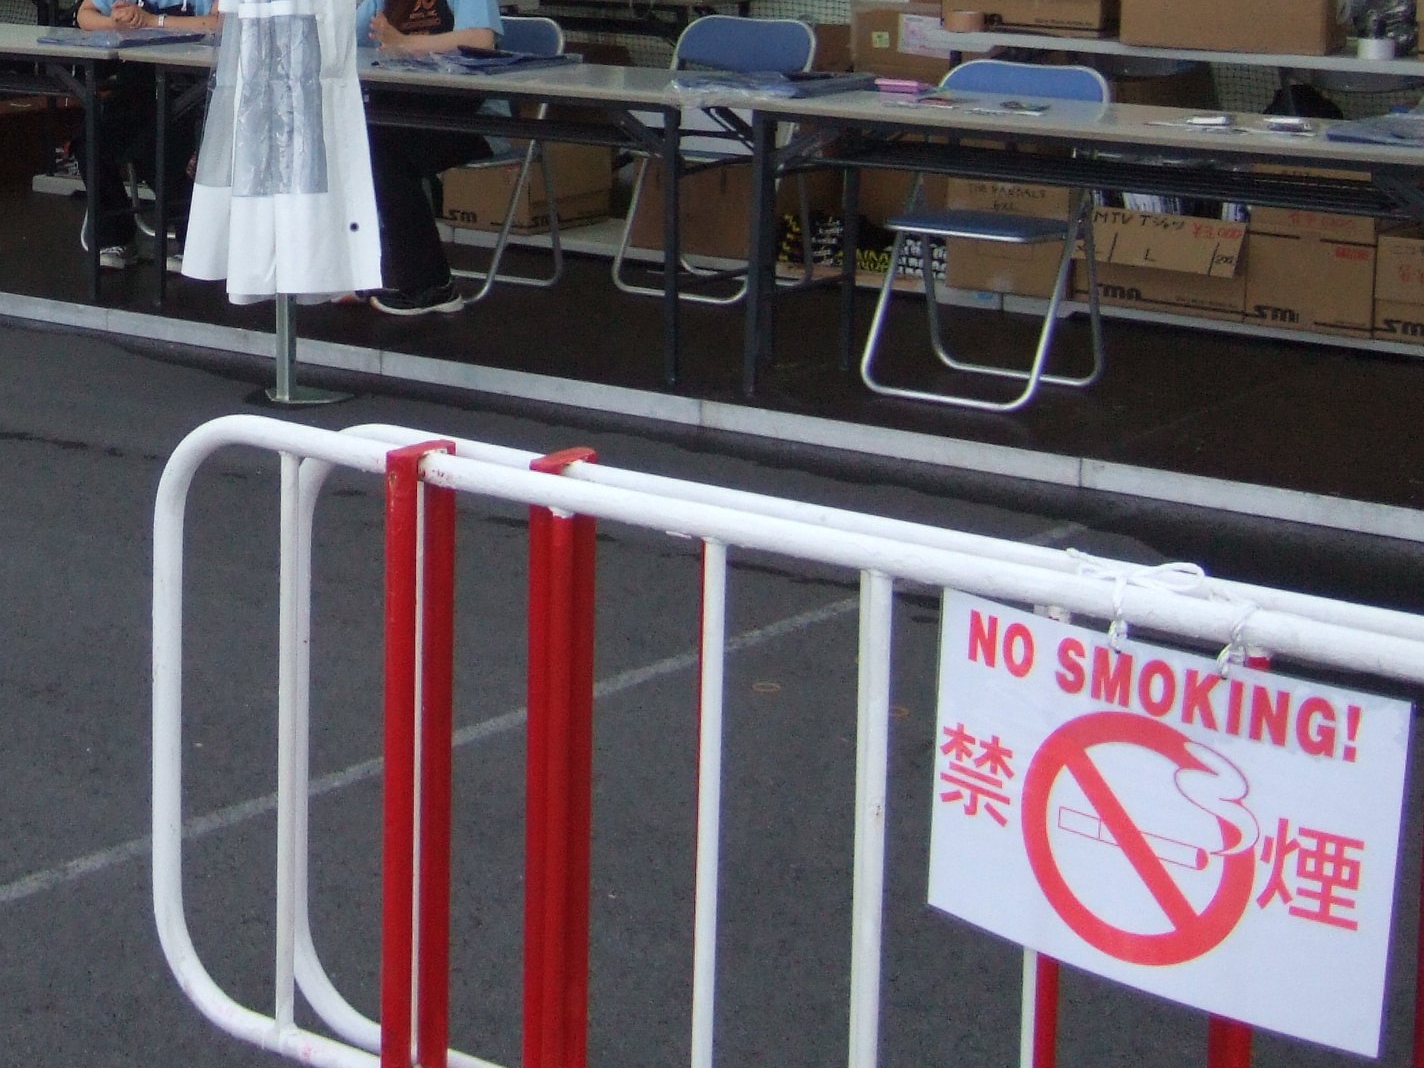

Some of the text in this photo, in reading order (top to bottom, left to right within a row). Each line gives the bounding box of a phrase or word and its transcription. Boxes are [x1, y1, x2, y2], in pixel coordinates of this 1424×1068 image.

[1094, 211, 1134, 225] MTV
[968, 609, 1364, 763] NO SMOKING!
[939, 722, 1366, 931] 禁 煙
